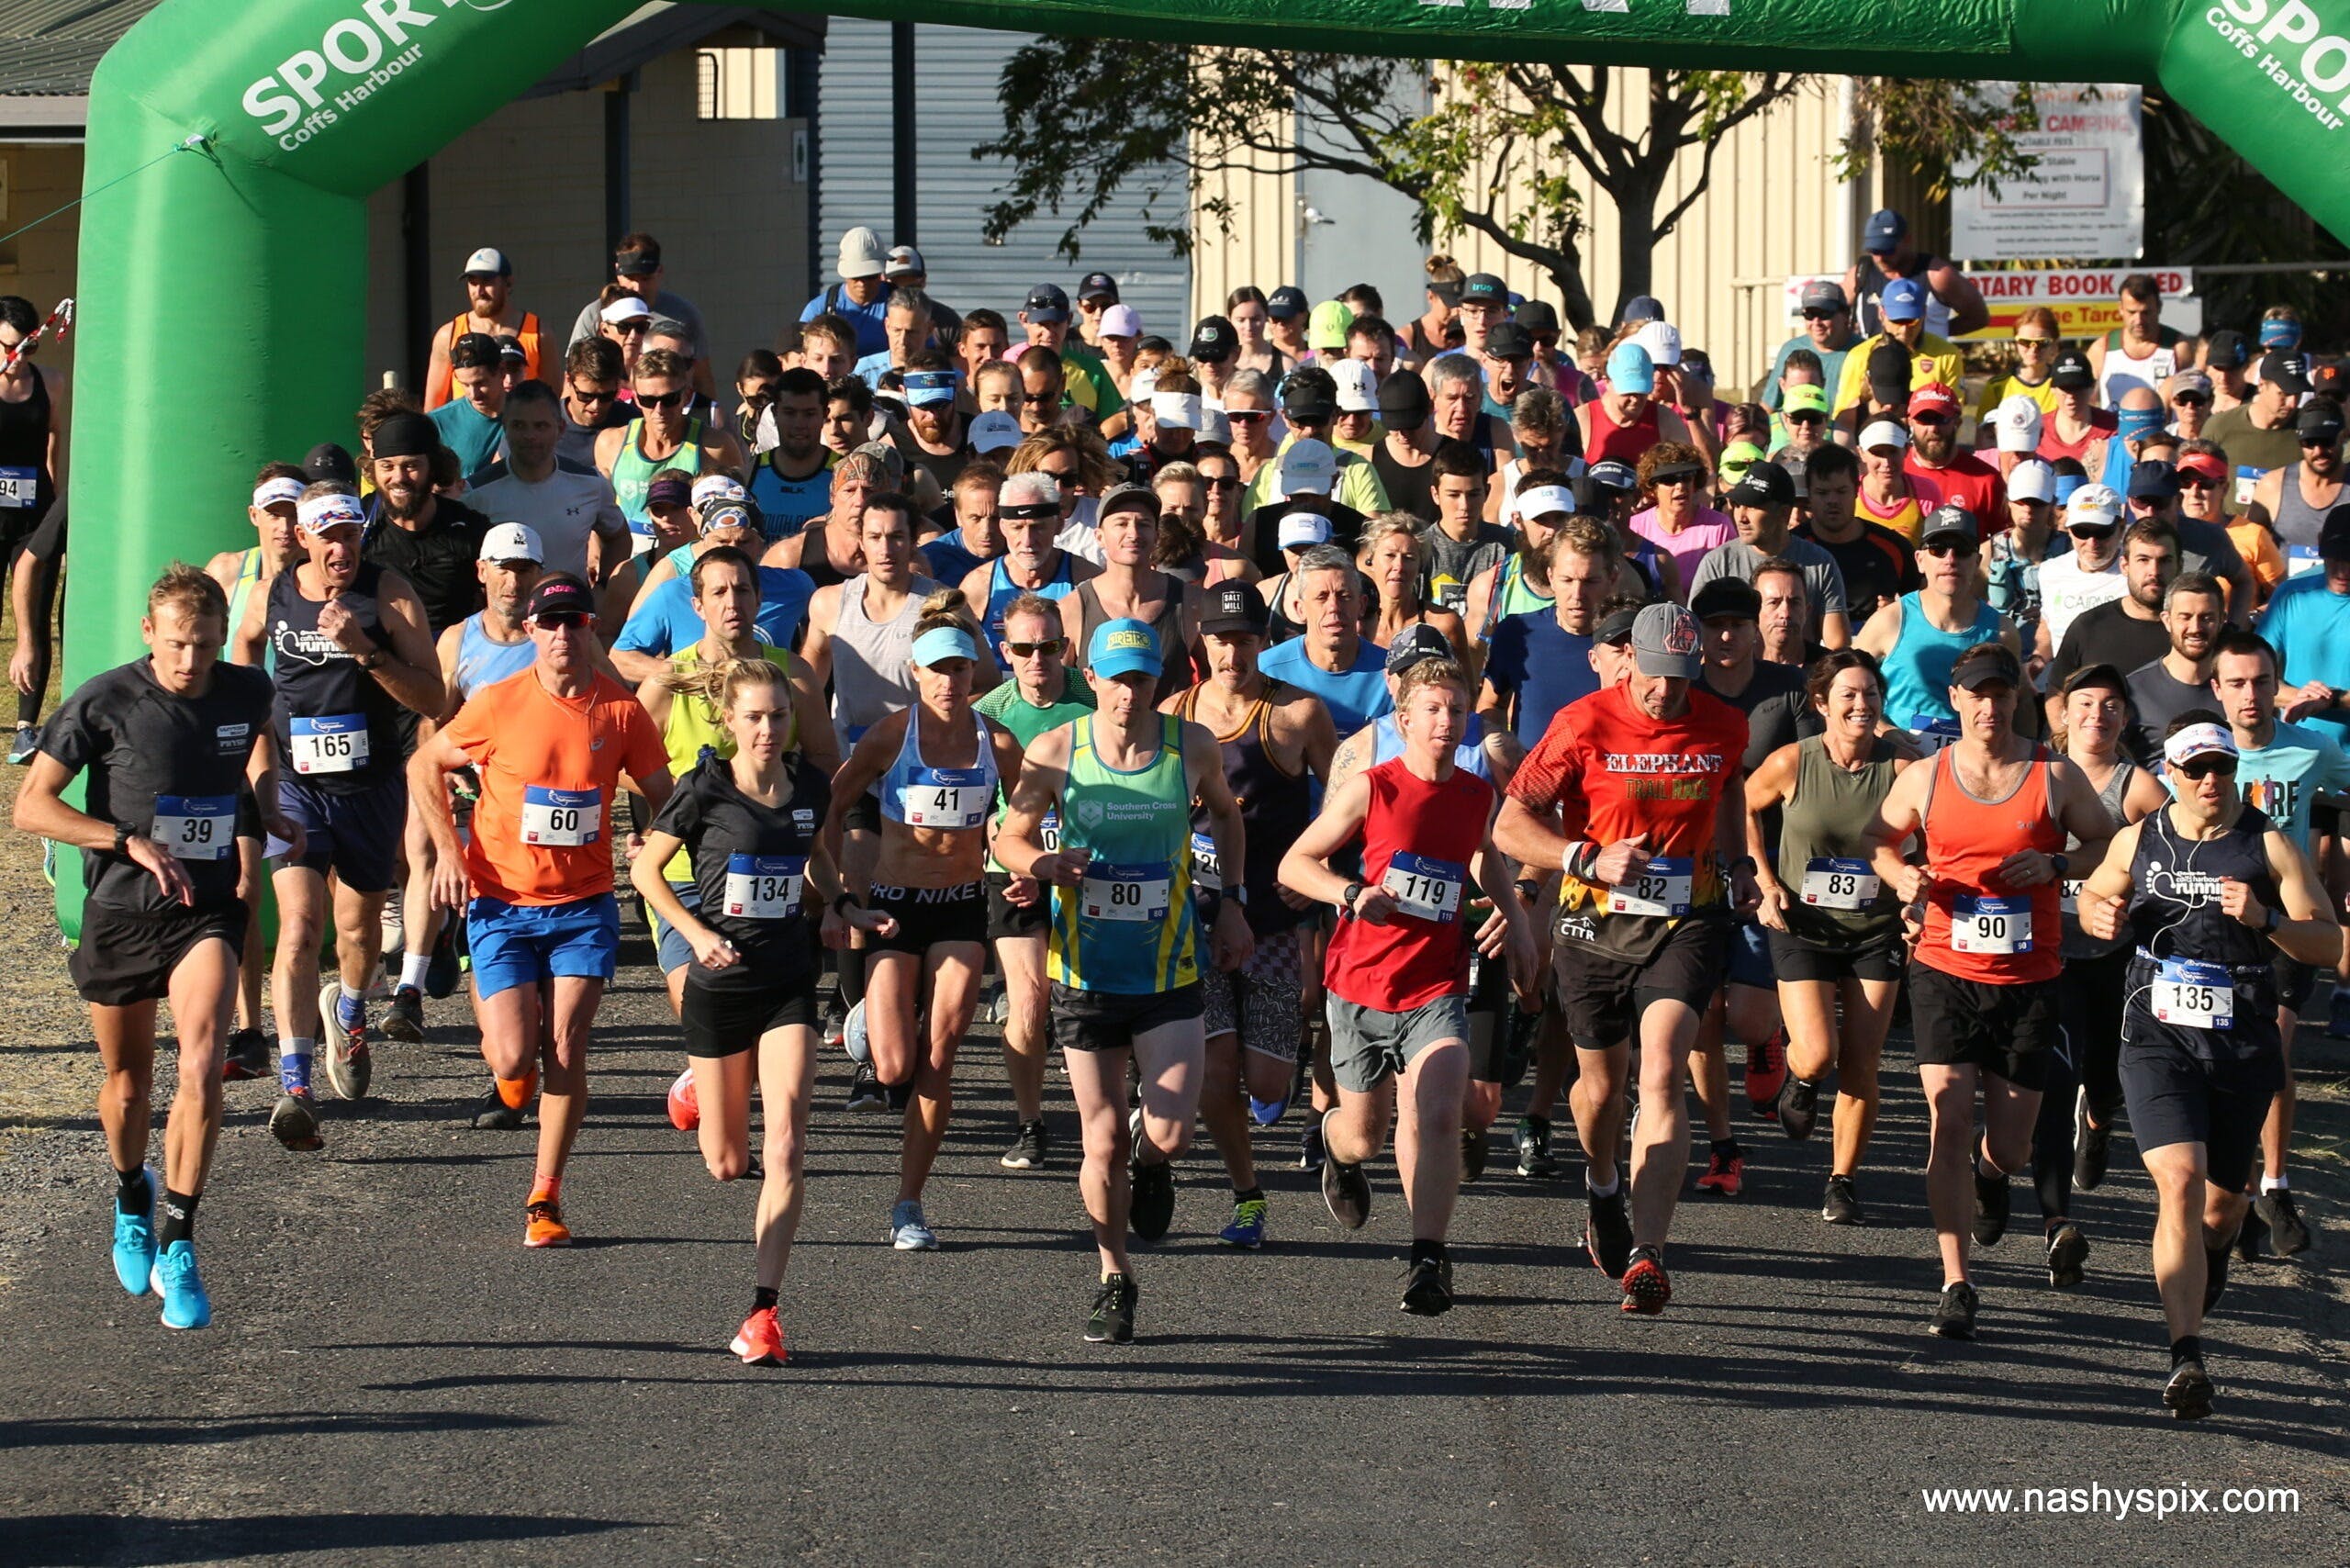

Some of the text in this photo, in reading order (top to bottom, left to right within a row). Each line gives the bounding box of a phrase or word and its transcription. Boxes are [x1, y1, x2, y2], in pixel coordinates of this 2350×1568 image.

[242, 0, 458, 137] SPOR
[2206, 6, 2344, 130] Coffs Harbour
[278, 42, 425, 152] Coffs Harbour
[2046, 114, 2132, 132] CAMPING
[2052, 174, 2072, 183] with
[2075, 174, 2101, 183] Horse
[2023, 190, 2066, 201] Per Night
[1970, 274, 2038, 297] OTARY
[2048, 274, 2115, 296] BOOK
[1224, 594, 1241, 602] SALT
[1224, 602, 1241, 610] MILL
[310, 734, 352, 758] 165
[354, 757, 367, 767] 165
[1604, 754, 1722, 774] ELEPHANT
[934, 788, 959, 812] 41
[1625, 778, 1708, 801] TRAIL RACE
[1107, 801, 1177, 812] Southern Cross
[1107, 812, 1155, 822] University
[182, 818, 213, 844] 39
[548, 808, 579, 832] 60
[749, 877, 789, 902] 134
[870, 881, 977, 904] PRO NIKE
[1111, 882, 1142, 906] 80
[1406, 875, 1447, 905] 119
[1638, 877, 1668, 901] 82
[1828, 874, 1855, 896] 83
[1561, 921, 1596, 942] CTTR
[1978, 916, 2007, 938] 90
[2173, 985, 2213, 1012] 135
[2215, 1017, 2229, 1026] 135
